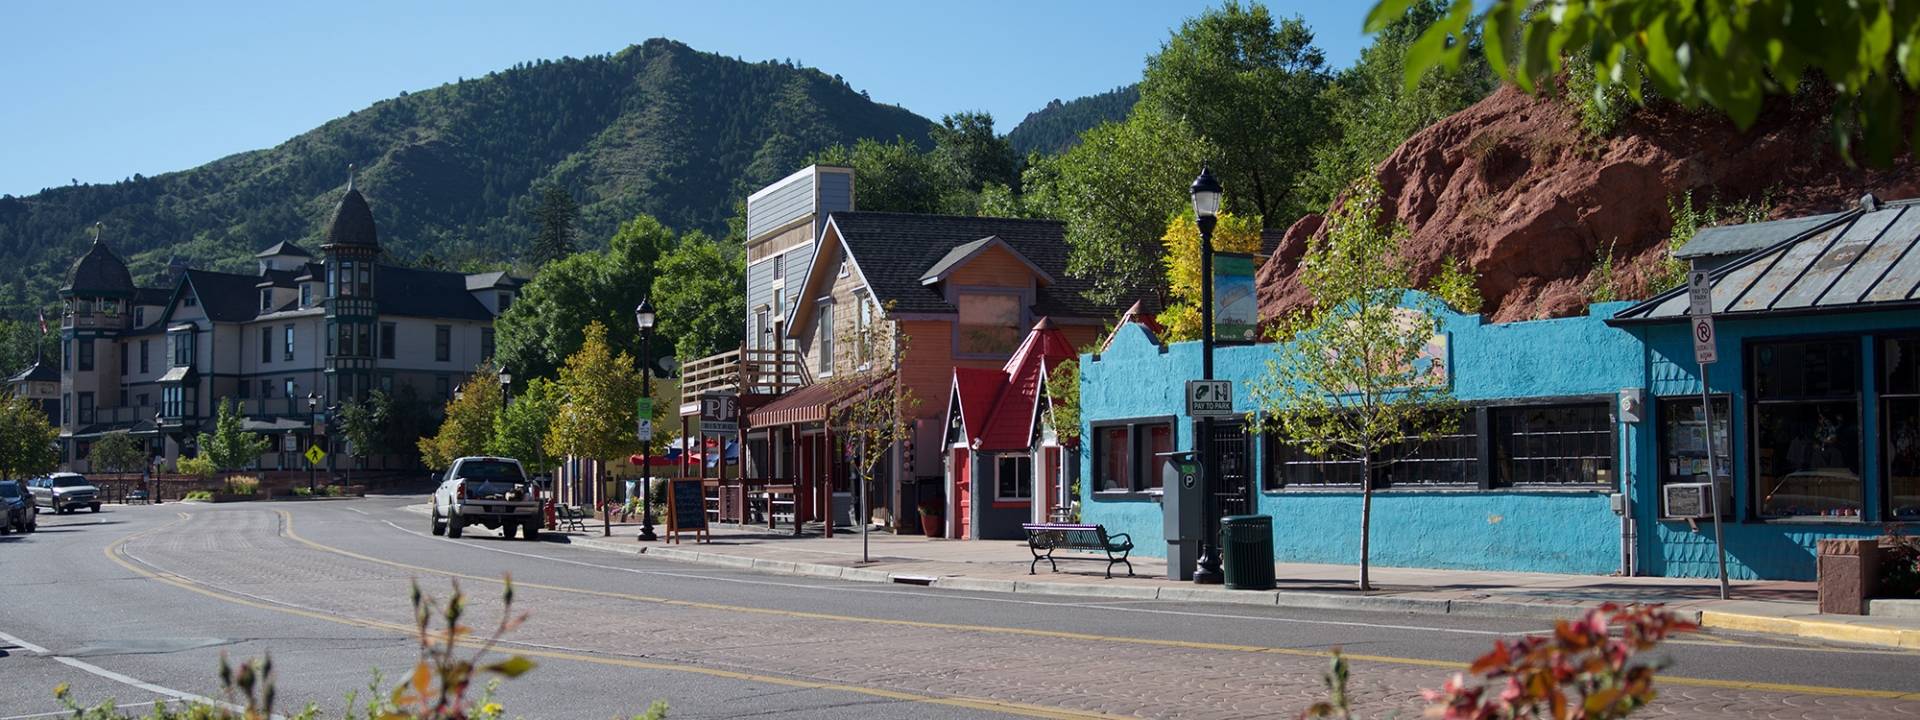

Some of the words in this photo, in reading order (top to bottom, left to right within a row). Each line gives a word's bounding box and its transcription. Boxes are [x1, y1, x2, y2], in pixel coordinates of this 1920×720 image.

[1194, 402, 1205, 410] PAY
[1206, 402, 1213, 410] TO
[1214, 402, 1231, 410] PARK
[704, 422, 733, 430] BISTRO
